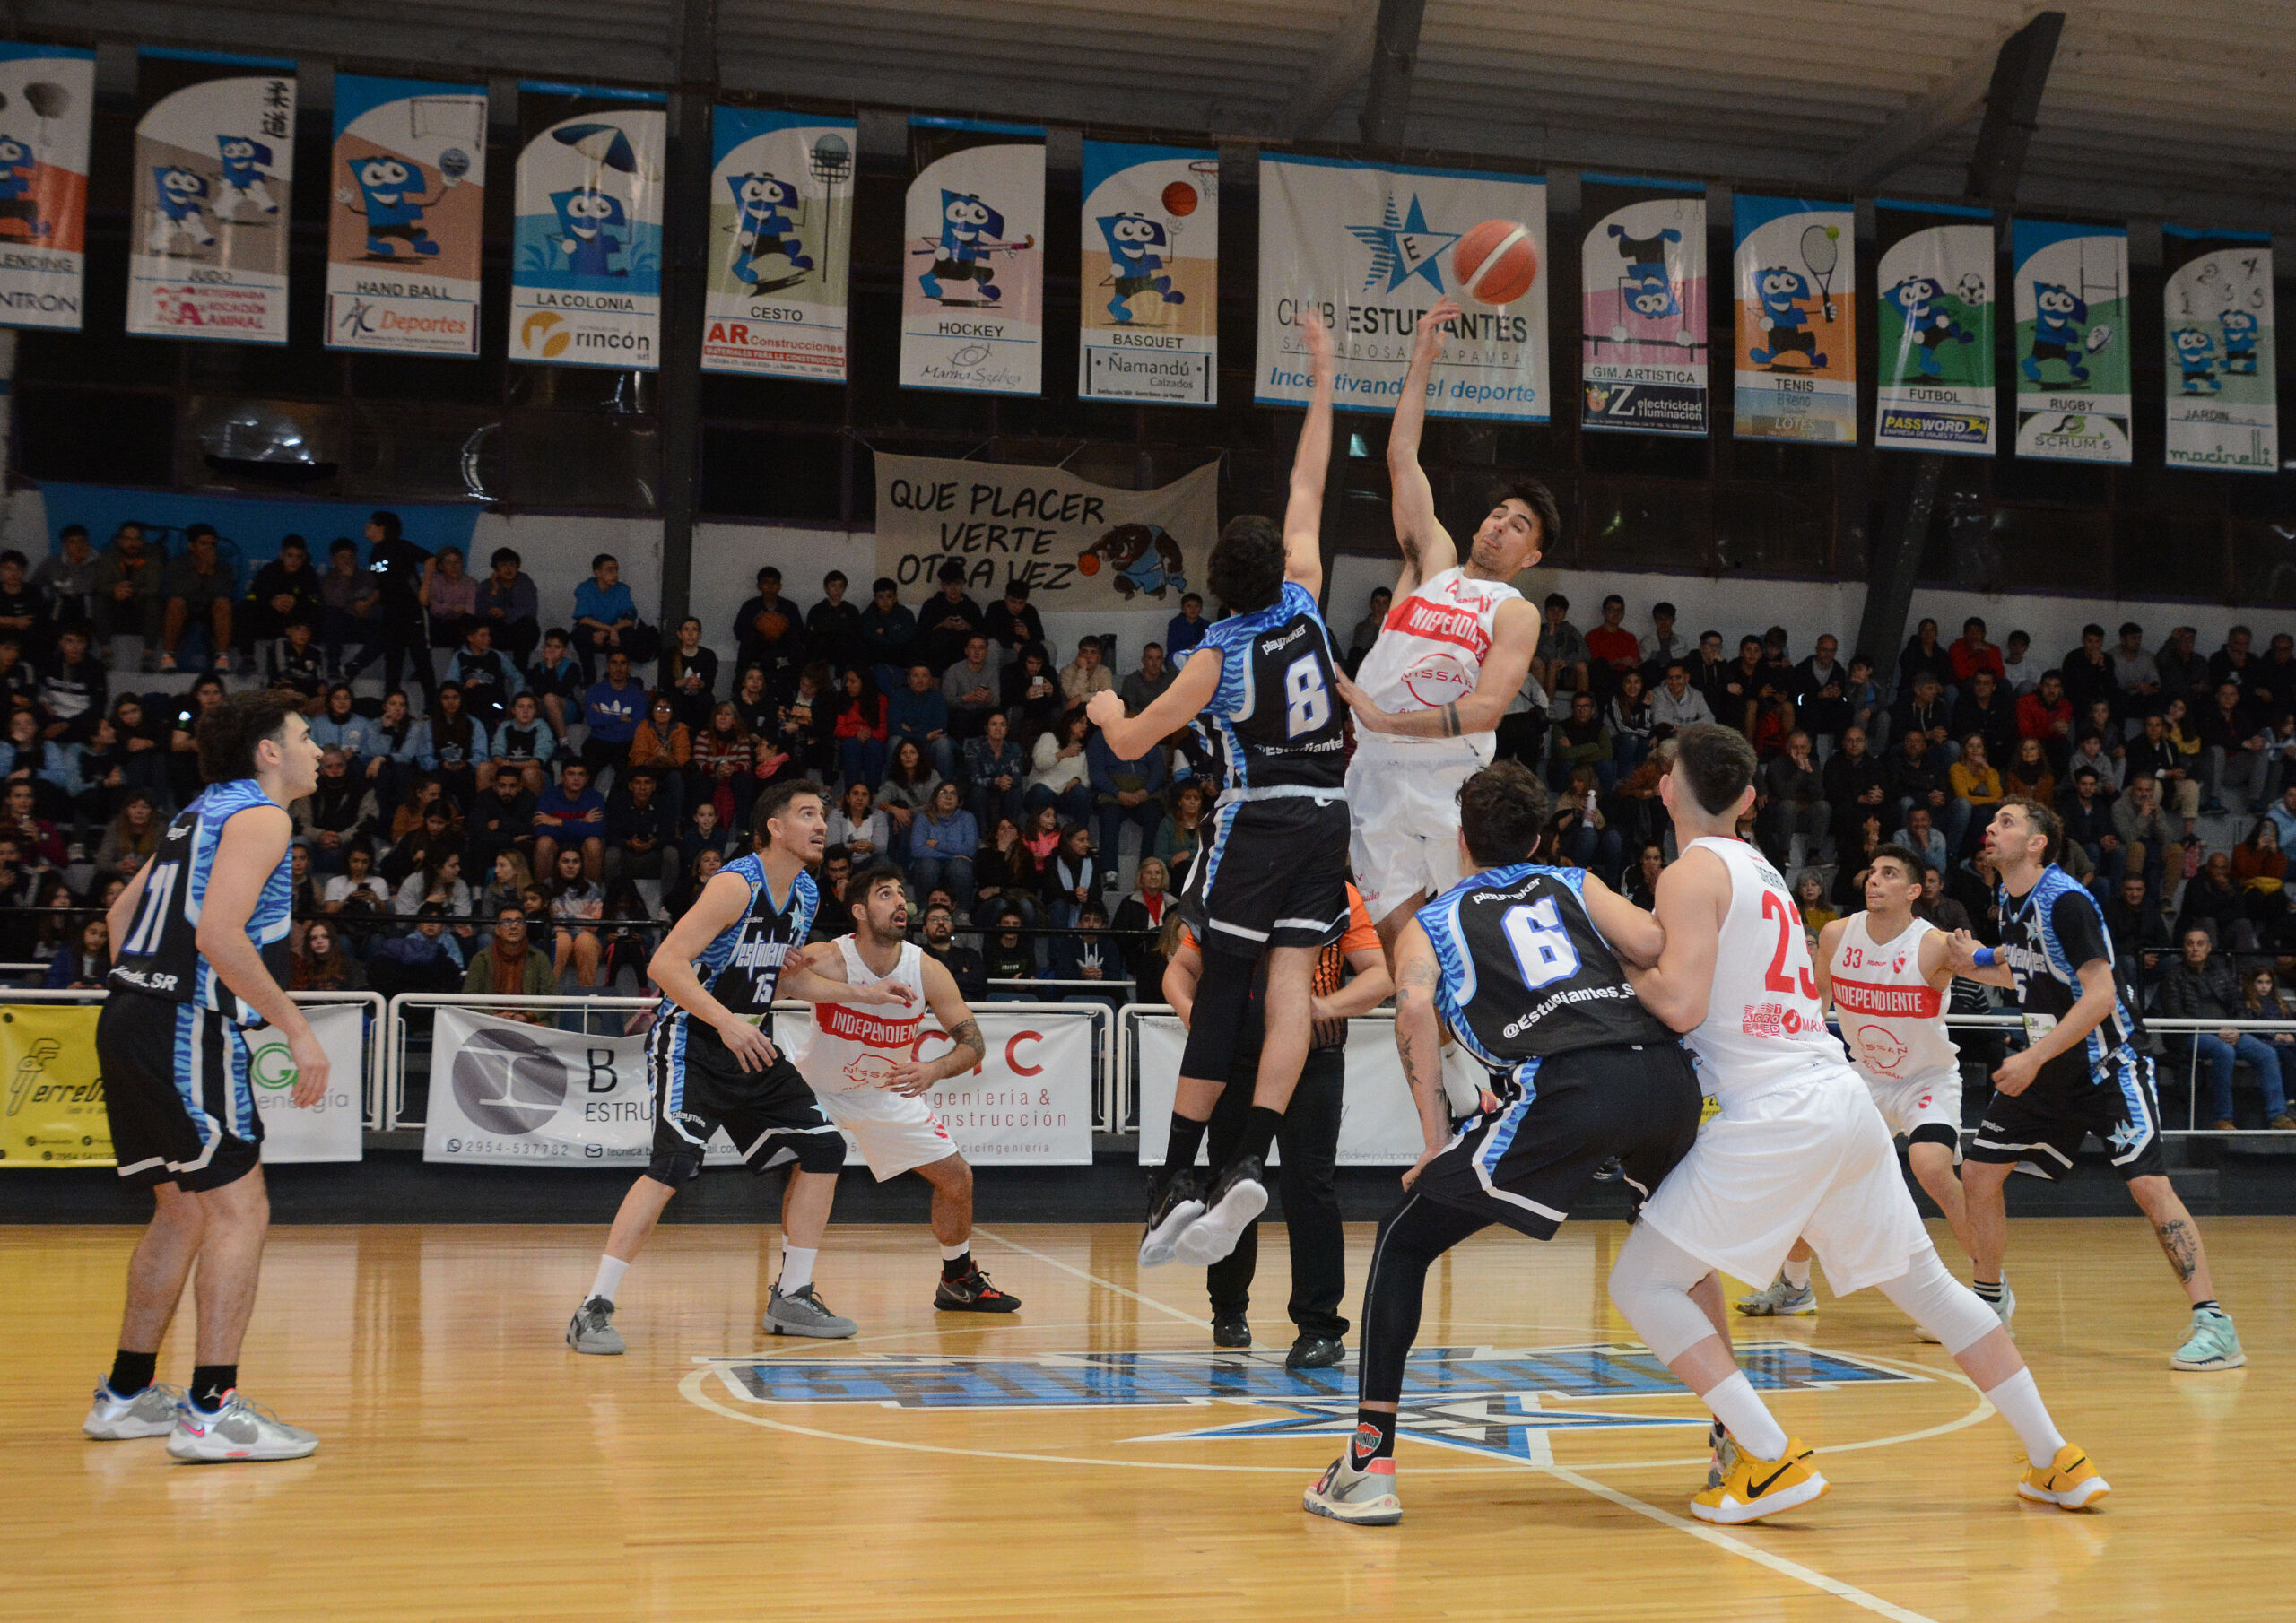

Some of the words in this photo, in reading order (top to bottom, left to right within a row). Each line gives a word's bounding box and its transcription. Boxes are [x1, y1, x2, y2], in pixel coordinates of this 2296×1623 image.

[1403, 236, 1421, 261] E
[357, 281, 404, 297] HAND
[409, 285, 452, 299] BALL
[536, 293, 558, 306] LA
[561, 294, 635, 310] COLONIA
[379, 310, 467, 334] Deportes
[751, 306, 804, 322] CESTO
[1347, 306, 1528, 343] ESTUANTES
[576, 330, 650, 351] rincón
[708, 323, 749, 345] AR
[939, 323, 1004, 337] HOCKEY
[750, 335, 844, 353] Construcciones
[1113, 334, 1184, 349] BASQUET
[1109, 352, 1190, 377] Ñamandú
[1354, 344, 1406, 360] ROSA
[1458, 351, 1523, 365] PAMPA
[1150, 377, 1194, 388] Calzados
[1593, 366, 1622, 378] GIM.
[1625, 369, 1695, 383] ARTISTICA
[1775, 378, 1814, 392] TENIS
[1451, 382, 1535, 404] deporte
[1909, 388, 1961, 403] FUTBOL
[1637, 398, 1702, 412] electricidad
[2050, 398, 2095, 412] RUGBY
[1775, 417, 1816, 430] LOTES
[1885, 416, 1966, 433] PASSWORD
[2035, 436, 2097, 449] SCRUM
[891, 479, 958, 512] QUE
[970, 483, 1104, 525] PLACER
[941, 522, 1057, 555] VERTE
[1009, 559, 1077, 590] VEZ
[1285, 649, 1332, 742] 8
[1472, 877, 1542, 905] playmaker
[121, 860, 181, 957] 11
[1500, 894, 1583, 993] 6
[1842, 947, 1863, 969] 33
[752, 973, 777, 1003] 15
[1833, 982, 1923, 1013] INDEPENDIENTE
[832, 1011, 918, 1044] INDEPENDIEN
[587, 1048, 618, 1094] B
[920, 1089, 1030, 1109] ngenieria
[1039, 1089, 1051, 1105] &
[586, 1102, 653, 1123] ESTRU
[942, 1111, 1068, 1128] nstrucción
[465, 1141, 570, 1156] 2954-537782
[961, 1141, 1050, 1154] cicingenieria
